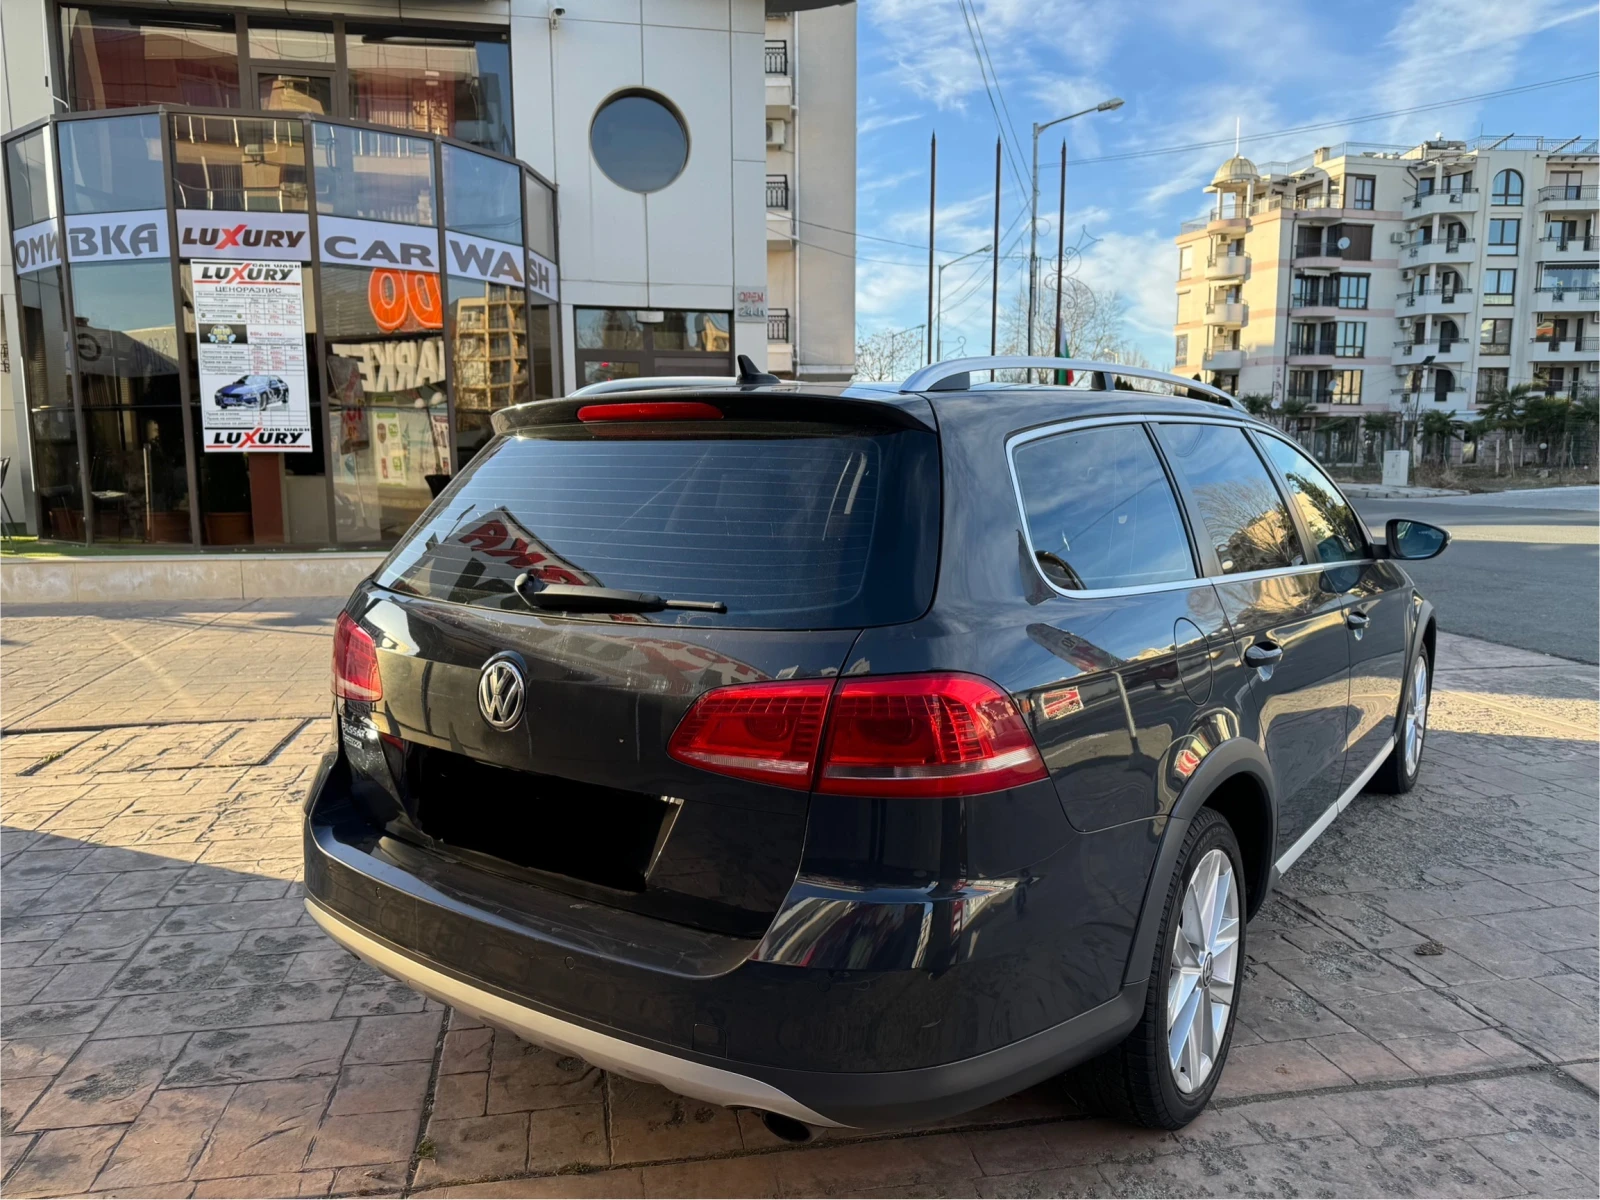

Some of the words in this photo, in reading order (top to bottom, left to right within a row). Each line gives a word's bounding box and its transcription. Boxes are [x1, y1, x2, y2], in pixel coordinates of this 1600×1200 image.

[182, 224, 306, 250] LUXURY
[324, 236, 434, 268] CAR
[202, 263, 293, 284] LUXURY
[215, 286, 282, 294] ЦЕНОРАЗПИС
[213, 427, 304, 448] LUXURY
